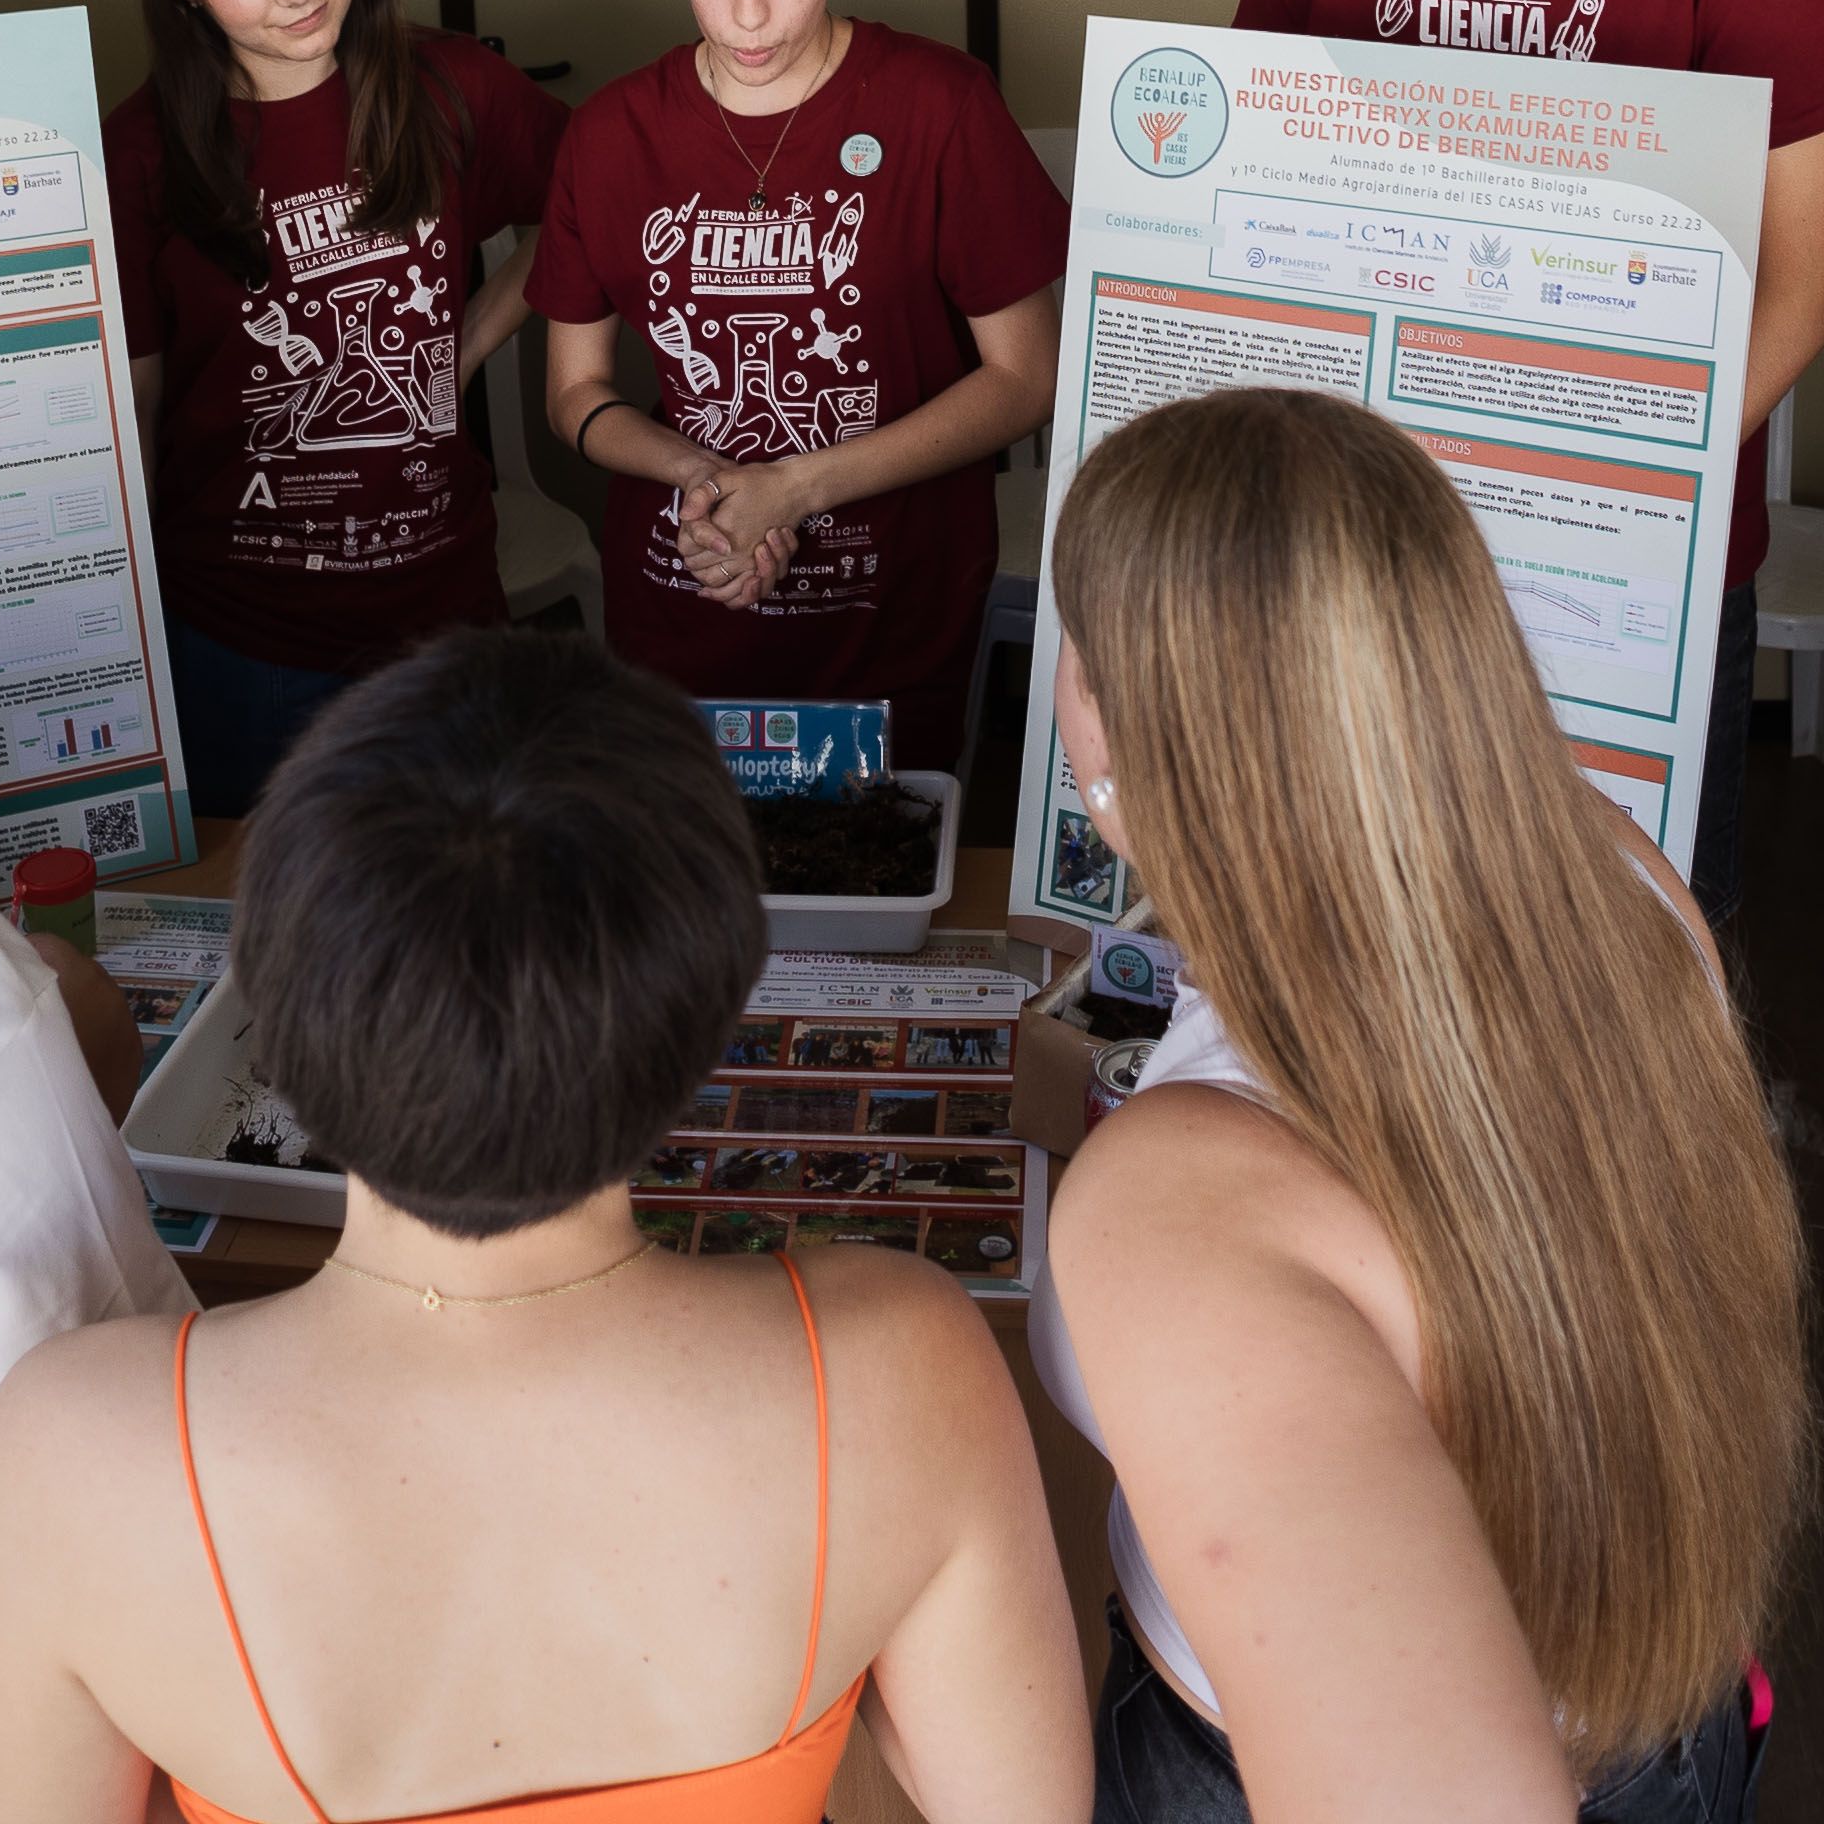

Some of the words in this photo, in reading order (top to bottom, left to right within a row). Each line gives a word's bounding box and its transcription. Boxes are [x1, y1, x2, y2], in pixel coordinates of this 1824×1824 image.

[1139, 67, 1206, 88] BENALUP
[1133, 87, 1208, 107] ECOALGAE
[1251, 67, 1443, 103] INVESTIGACIÓN
[1453, 87, 1500, 109] DEL
[1509, 93, 1611, 120] EFECTO
[1621, 104, 1654, 125] DE
[1236, 89, 1430, 126] RUGULOPTERYX
[1438, 110, 1584, 143] OKAMURAE
[1593, 127, 1627, 147] EN
[1637, 131, 1667, 152] EL
[24, 128, 58, 143] 22.23
[1283, 118, 1389, 146] CULTIVO
[1398, 130, 1430, 151] DE
[1438, 134, 1608, 171] BERENJENAS
[1165, 143, 1188, 154] CASAS
[1163, 155, 1186, 166] VIEJAS
[1330, 153, 1393, 172] Alumnado
[1399, 162, 1415, 174] de
[1441, 166, 1524, 187] Bachillerato
[1531, 177, 1587, 196] Biología
[271, 202, 282, 213] XI
[284, 192, 318, 209] FERIA
[319, 186, 334, 199] DE
[1231, 166, 1237, 176] y
[1262, 167, 1292, 181] Ciclo
[1298, 171, 1336, 186] Medio
[1341, 176, 1438, 198] Agrojardinería
[1444, 190, 1464, 201] del
[1470, 192, 1491, 205] IES
[1498, 195, 1543, 211] CASAS
[1551, 202, 1600, 218] VIEJAS
[1613, 208, 1653, 225] Curso
[1660, 214, 1701, 231] 22.23
[276, 196, 366, 256] CIEN
[697, 209, 709, 220] XI
[711, 209, 746, 222] FERIA
[747, 211, 763, 222] DE
[765, 209, 780, 220] LA
[1105, 213, 1204, 239] Colaboradores:
[690, 222, 815, 268] CIENCIA
[289, 262, 304, 273] EN
[305, 257, 319, 268] LA
[321, 247, 354, 264] CALLE
[355, 242, 370, 254] DE
[1268, 255, 1332, 273] FPEMPRESA
[1531, 242, 1618, 276] Verinsur
[1652, 270, 1697, 287] Barbate
[691, 273, 707, 284] EN
[708, 273, 721, 284] LA
[723, 273, 759, 285] CALLE
[760, 273, 775, 284] DE
[777, 272, 812, 284] JEREZ
[1375, 269, 1435, 293] CSIC
[1467, 268, 1509, 291] UCA
[1097, 279, 1177, 302] INTRODUCCIÓN
[1566, 291, 1637, 309] COMPOSTAJE
[1398, 326, 1464, 348] OBJETIVOS
[790, 565, 835, 575] HOLCIM
[782, 956, 846, 965] CULTIVO
